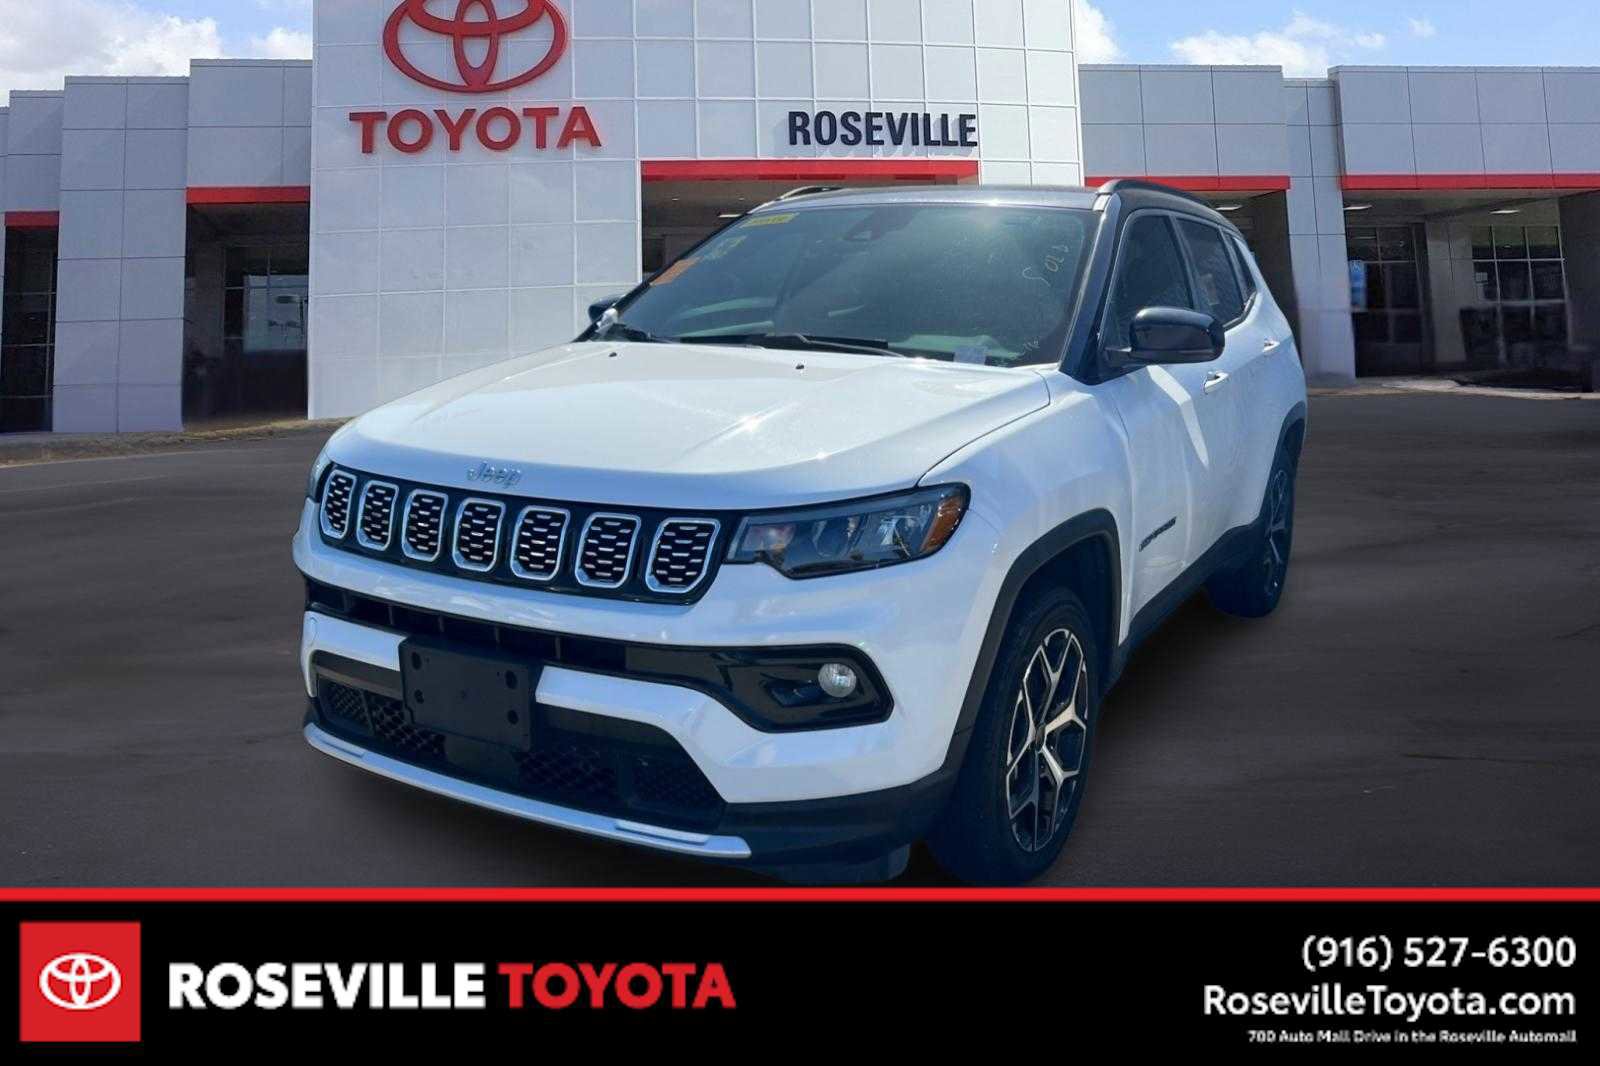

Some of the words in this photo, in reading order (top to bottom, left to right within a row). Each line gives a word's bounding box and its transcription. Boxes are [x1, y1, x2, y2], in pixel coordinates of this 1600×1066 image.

[349, 106, 602, 154] TOYOTA
[788, 110, 979, 147] ROSEVILLE
[465, 461, 522, 488] Jeep
